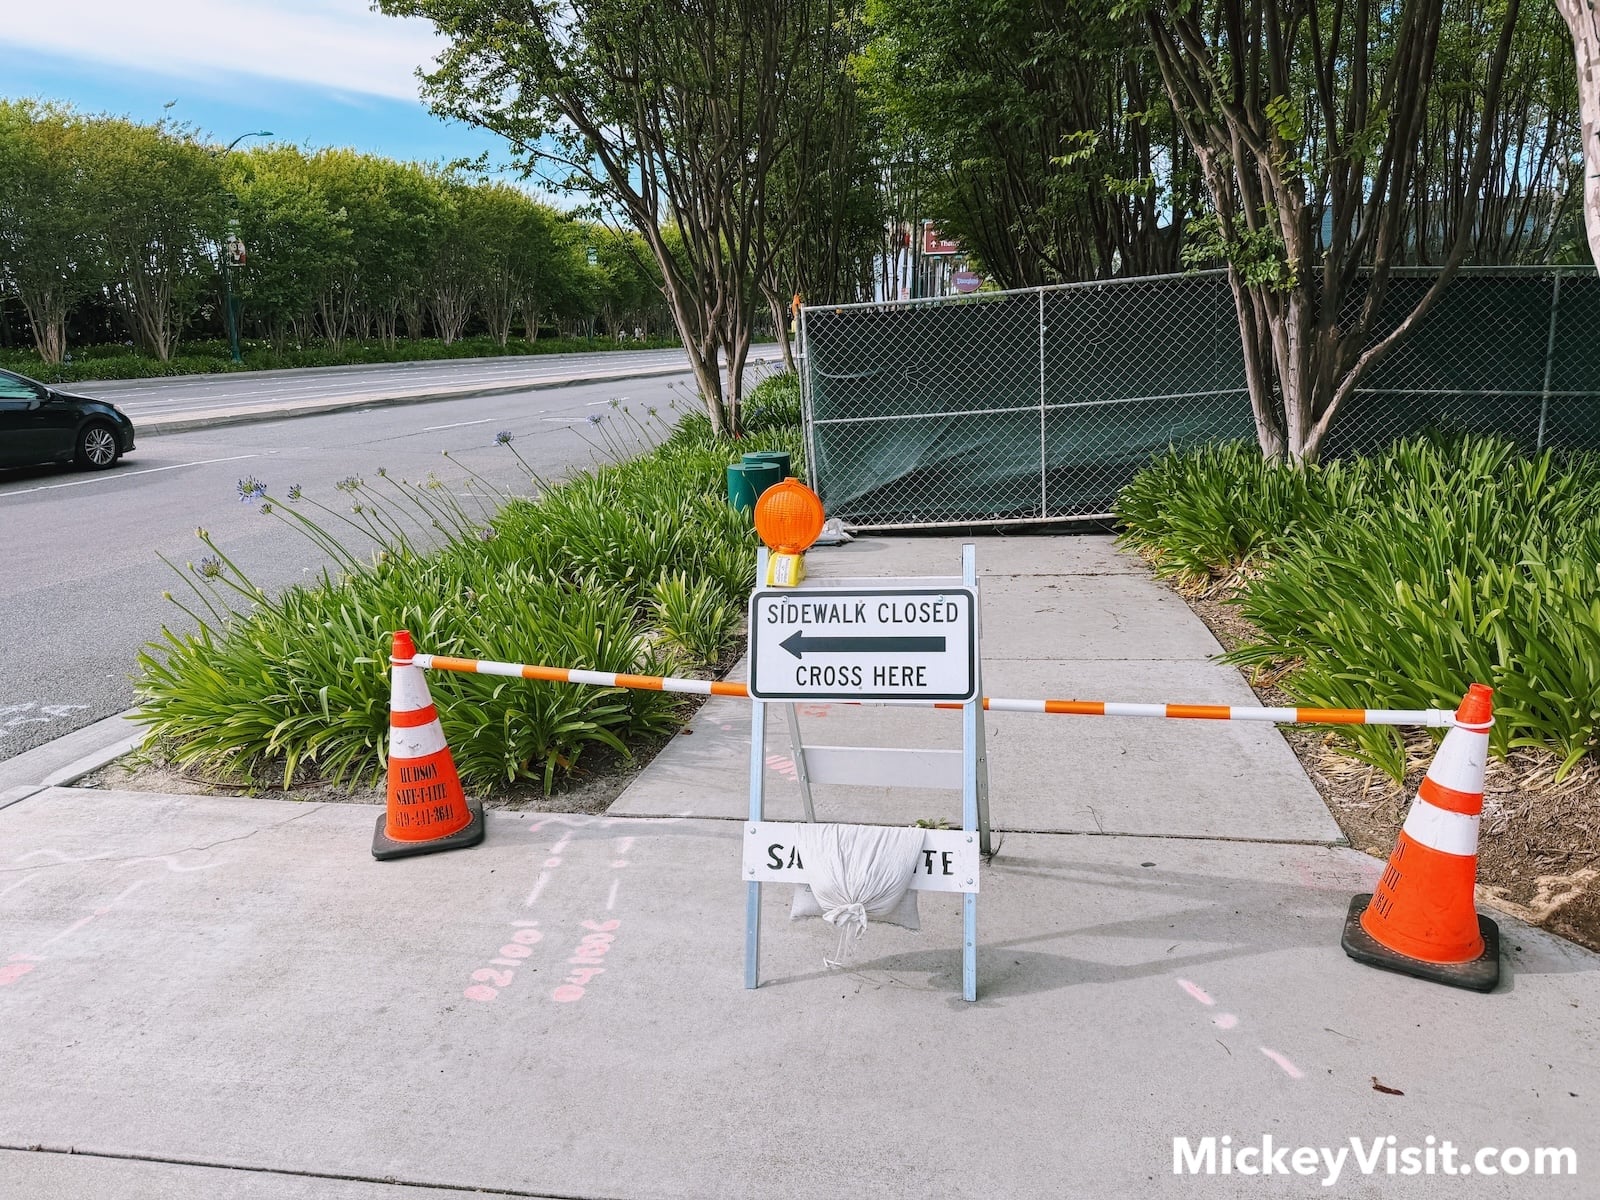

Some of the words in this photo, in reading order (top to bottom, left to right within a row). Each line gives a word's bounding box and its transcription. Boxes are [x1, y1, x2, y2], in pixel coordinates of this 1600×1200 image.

[767, 603, 866, 624] SIDEWALK
[878, 602, 958, 623] CLOSED
[796, 665, 862, 687] CROSS
[873, 666, 927, 687] HERE
[400, 762, 438, 783] HUDSON
